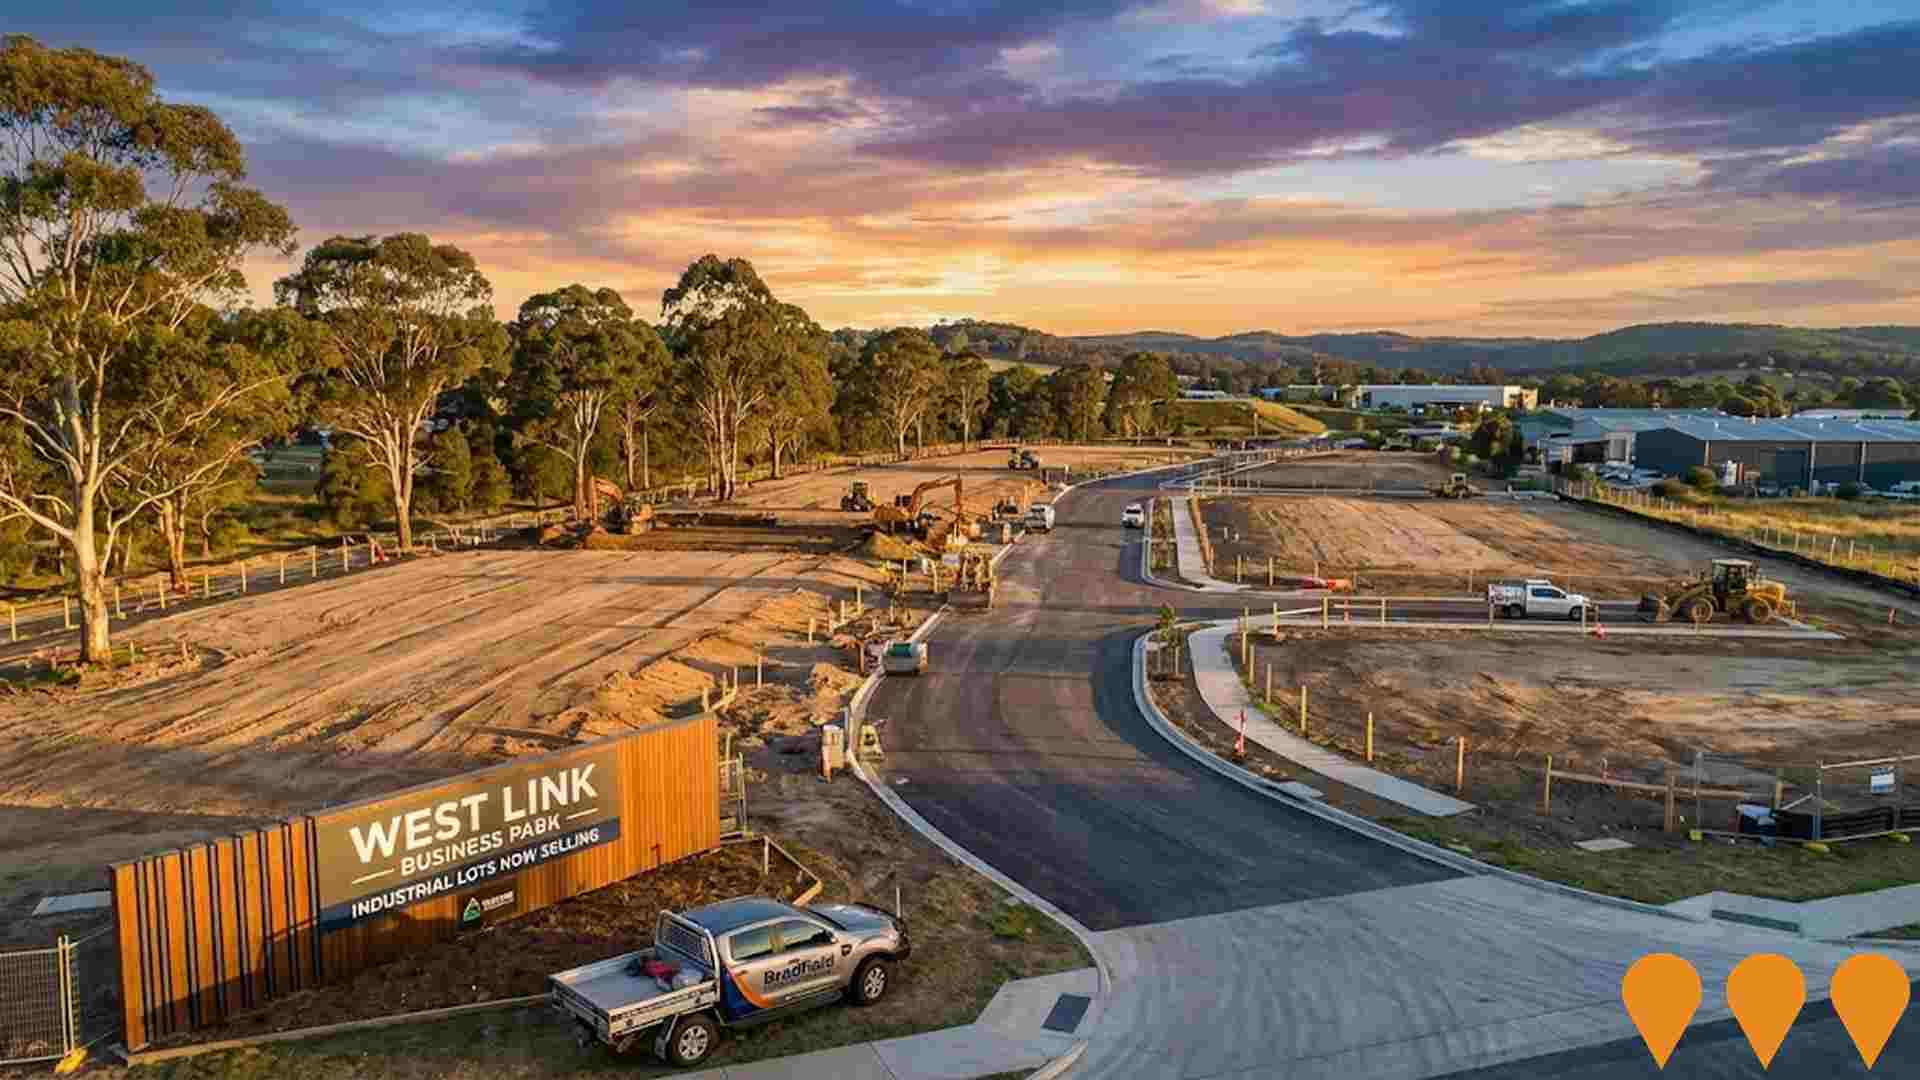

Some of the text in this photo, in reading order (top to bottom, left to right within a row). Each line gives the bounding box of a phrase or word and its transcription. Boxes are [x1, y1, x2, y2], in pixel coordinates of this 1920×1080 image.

[349, 764, 599, 863] WEST LINK
[400, 832, 503, 877] BUSINESS
[351, 877, 453, 918] INDUSTRIAL
[457, 860, 497, 885] LOTS
[500, 848, 538, 870] NOW
[541, 828, 600, 859] SELLING
